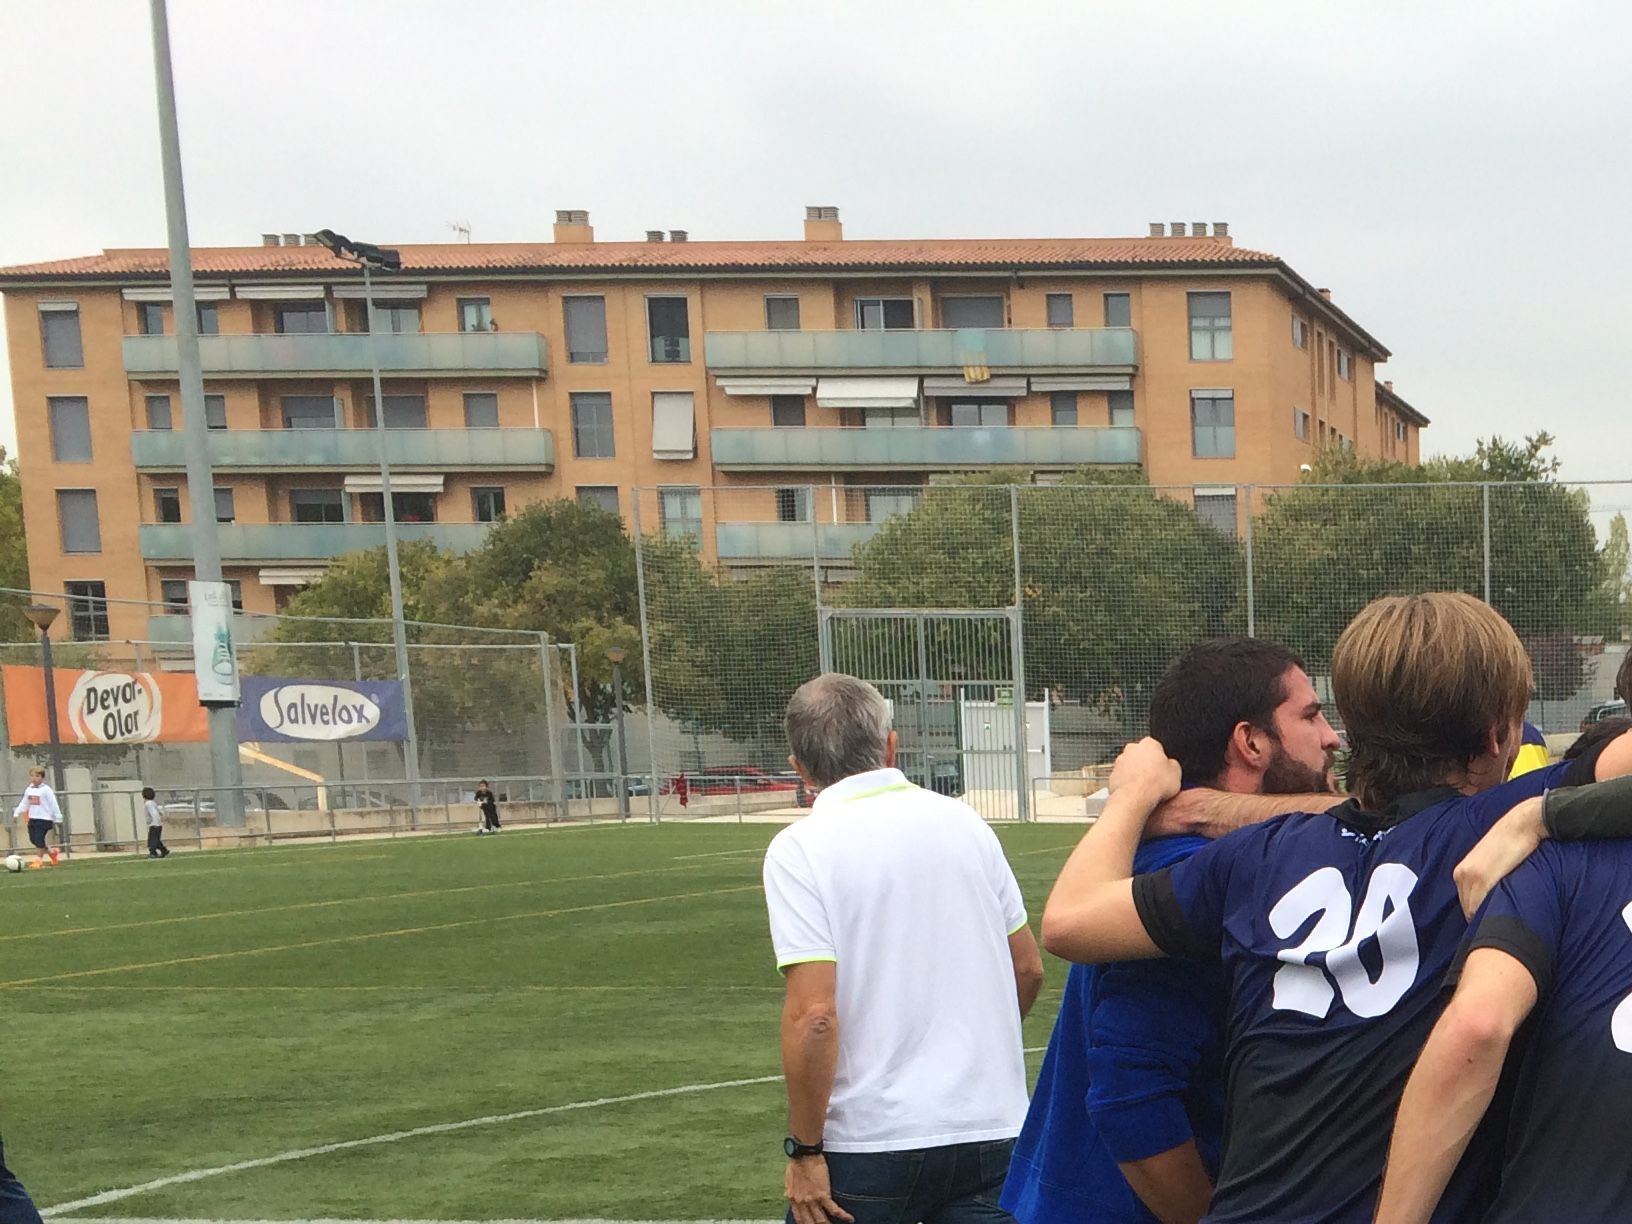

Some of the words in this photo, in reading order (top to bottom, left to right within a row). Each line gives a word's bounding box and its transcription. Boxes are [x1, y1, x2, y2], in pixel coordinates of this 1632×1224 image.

[86, 679, 142, 715] Devor-
[273, 687, 370, 729] Salvelox
[103, 709, 139, 740] Olor
